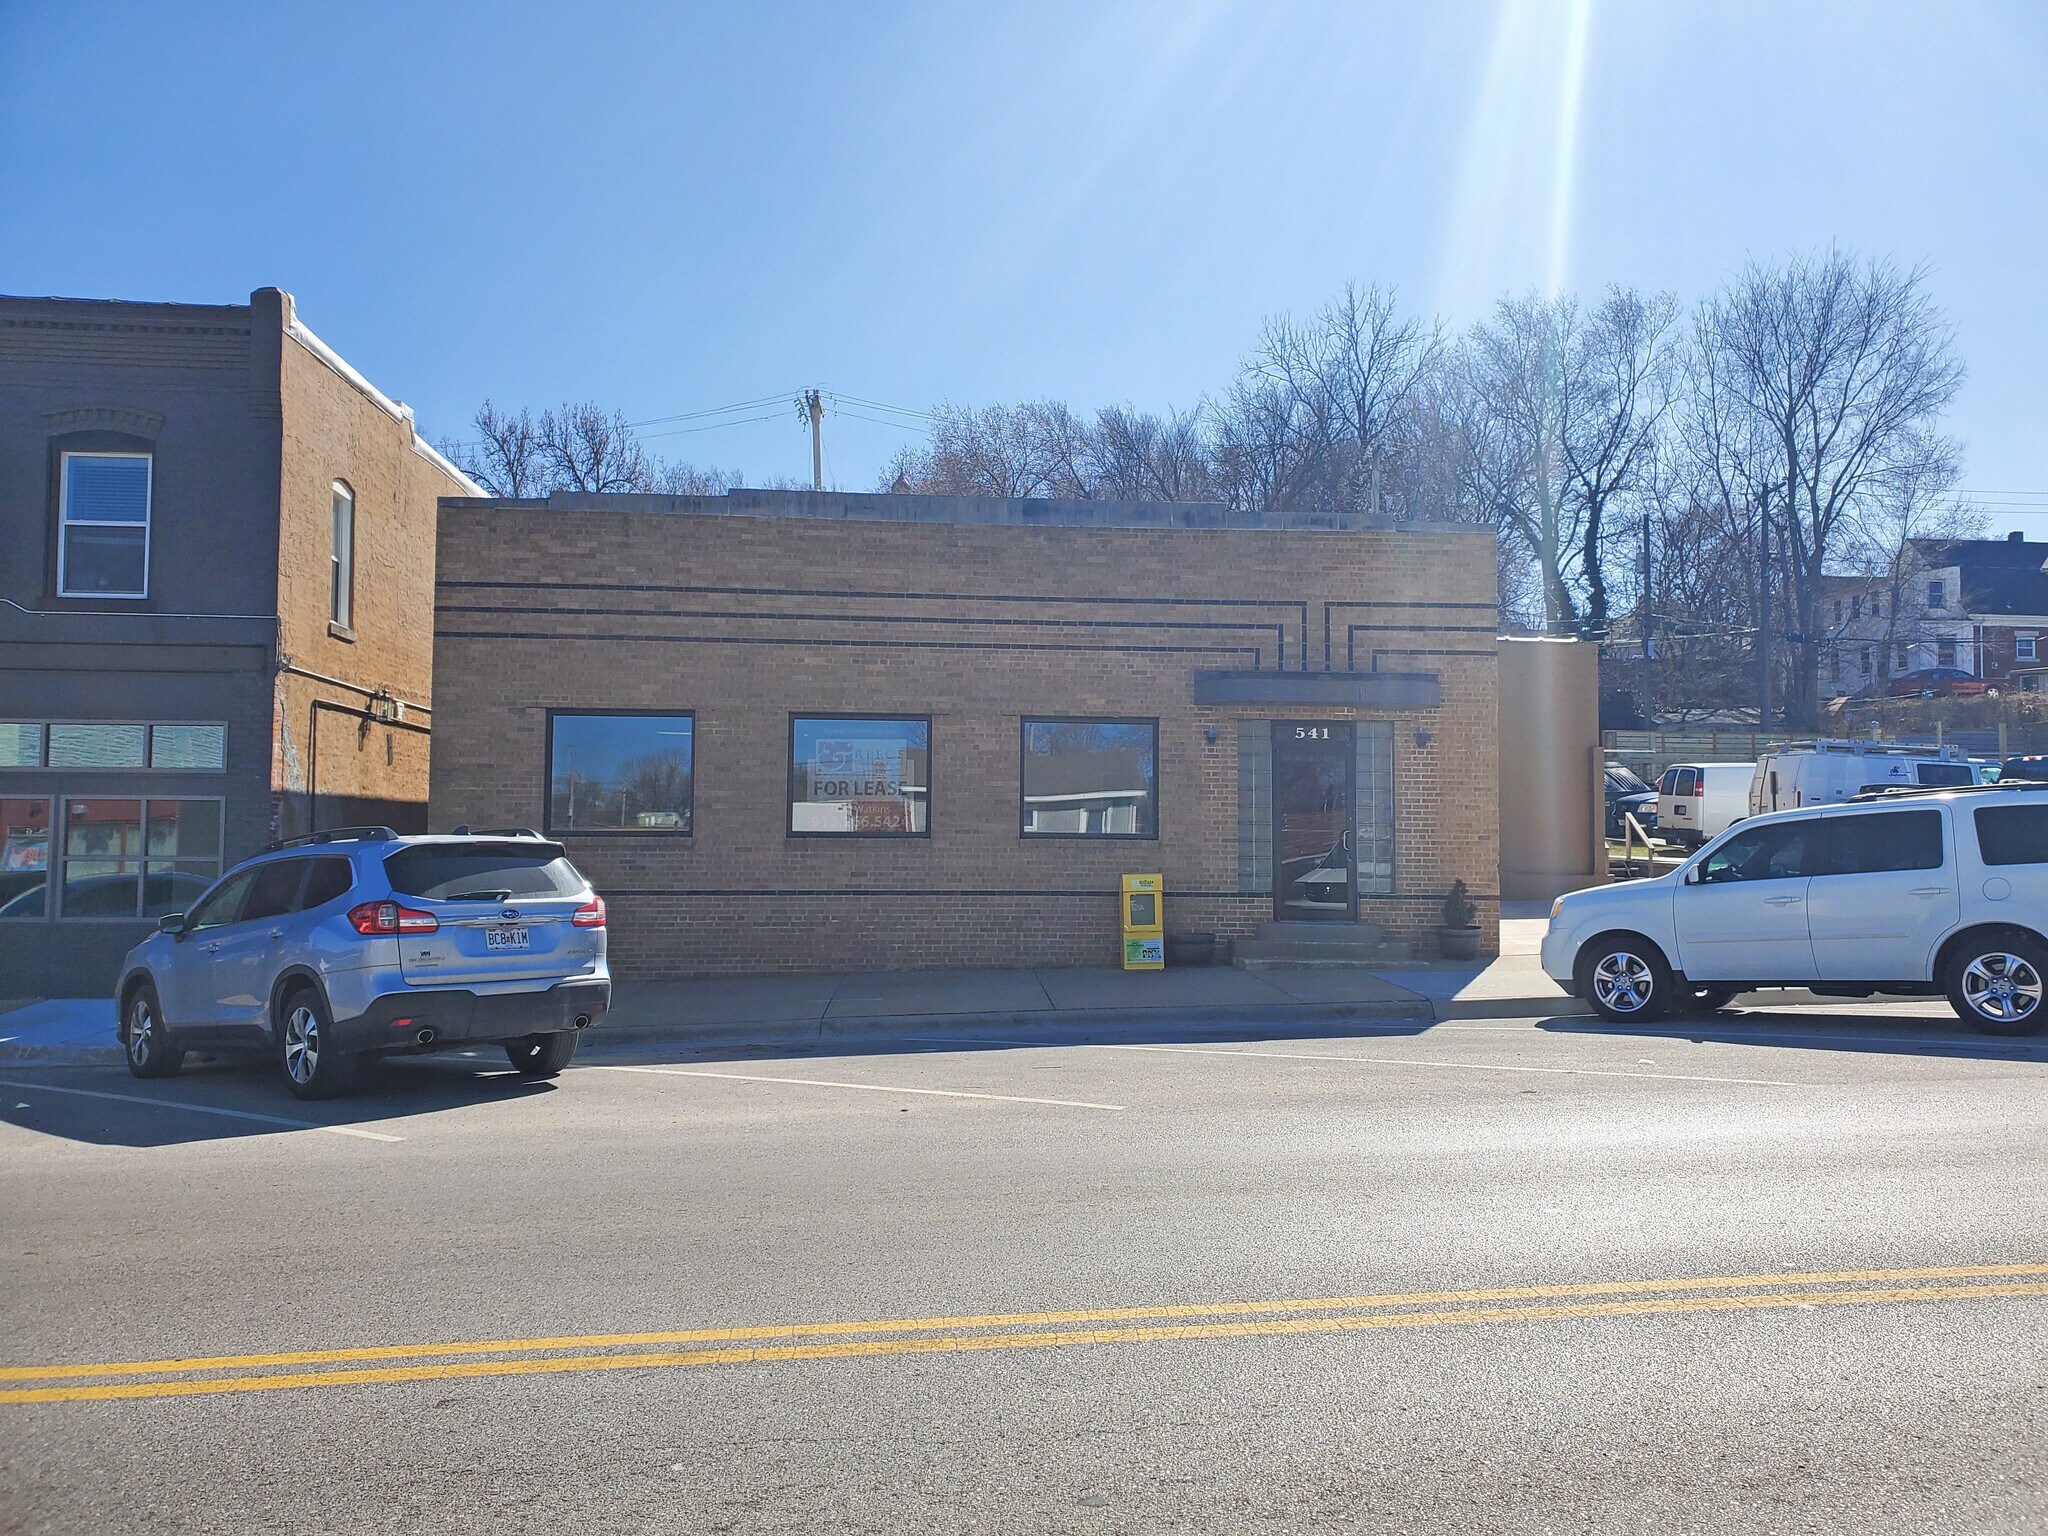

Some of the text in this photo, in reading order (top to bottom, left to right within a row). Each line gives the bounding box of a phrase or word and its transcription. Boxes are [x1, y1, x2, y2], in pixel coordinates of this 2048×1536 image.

[1294, 727, 1330, 739] 541
[813, 780, 908, 796] FOR LEASE
